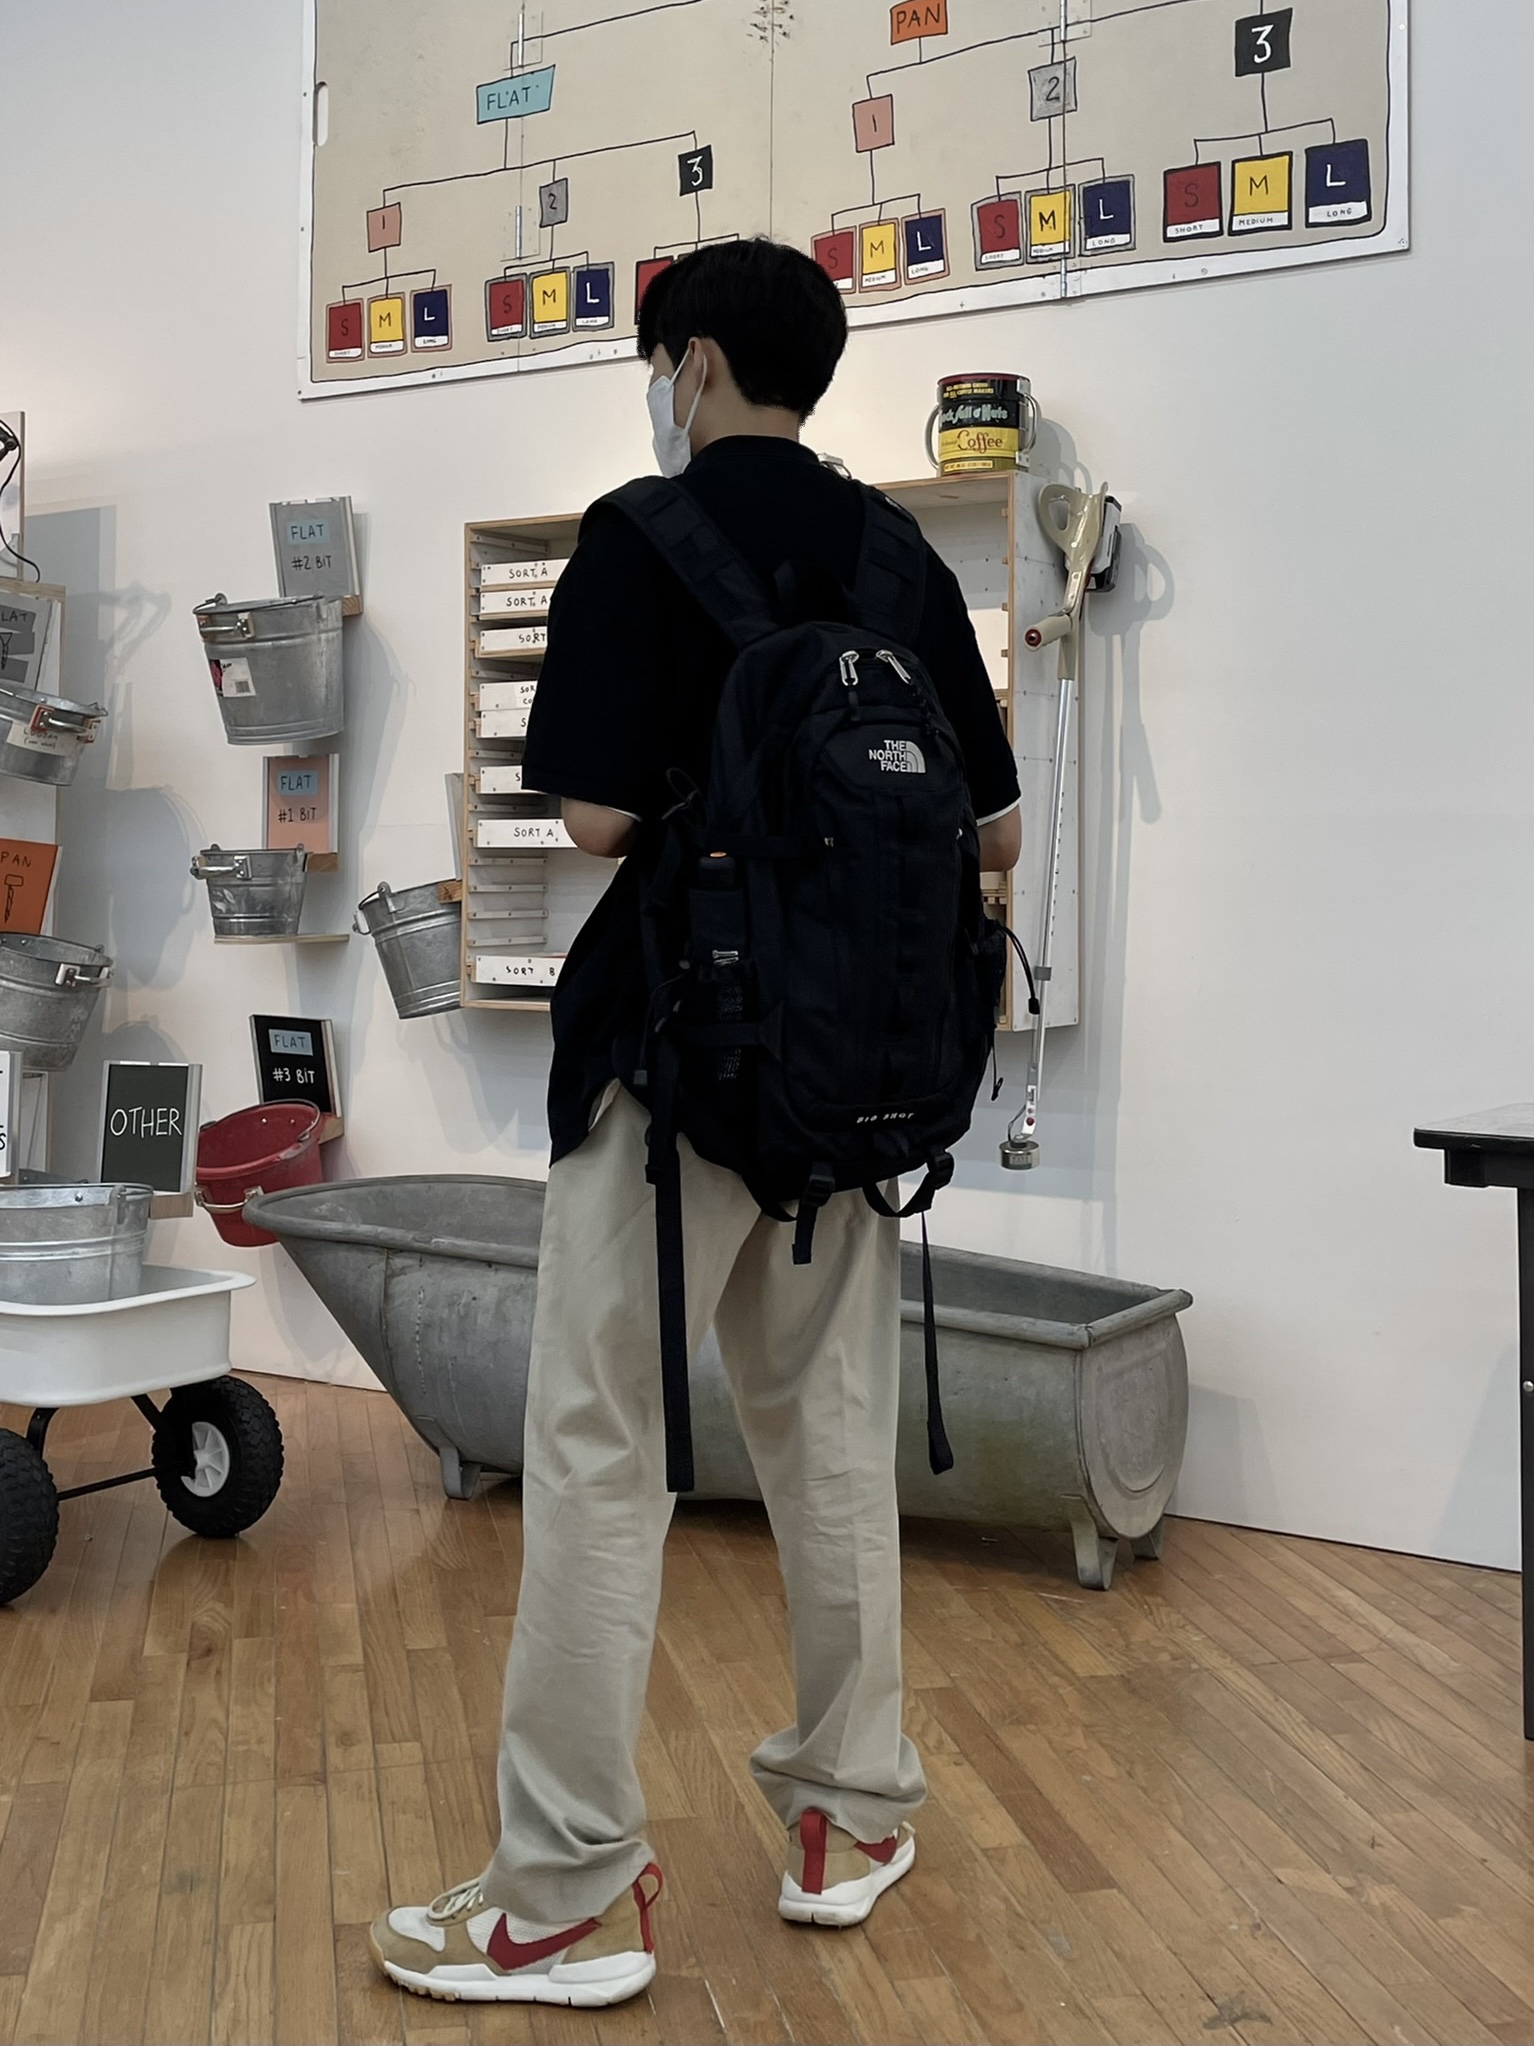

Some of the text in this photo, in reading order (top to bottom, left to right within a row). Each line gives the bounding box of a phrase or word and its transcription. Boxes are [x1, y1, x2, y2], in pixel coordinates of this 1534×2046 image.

[896, 3, 940, 34] PAN
[1251, 24, 1274, 63] 3
[1045, 76, 1061, 101] 2
[487, 86, 531, 111] FLAT
[687, 155, 703, 186] 3
[1326, 163, 1346, 187] L
[1249, 174, 1269, 196] M
[548, 193, 558, 210] 2
[1184, 182, 1199, 208] S
[1099, 199, 1114, 220] L
[1327, 208, 1352, 217] LONG
[993, 214, 1005, 239] S
[1038, 209, 1056, 232] M
[1238, 217, 1274, 226] MEDIUM
[1174, 224, 1204, 234] SHORT
[870, 240, 884, 258] M
[917, 231, 932, 251] L
[1092, 237, 1116, 246] LONG
[827, 247, 838, 269] S
[542, 288, 556, 306] M
[586, 282, 600, 303] L
[502, 295, 512, 314] S
[379, 312, 391, 328] M
[424, 307, 436, 321] L
[341, 318, 349, 336] S
[957, 429, 1003, 454] Coffee
[290, 524, 324, 540] FLAT
[291, 556, 311, 571] #2
[541, 567, 548, 576] A
[540, 595, 548, 605] A
[0, 611, 28, 622] LAT
[519, 632, 546, 643] SORT
[520, 685, 536, 694] SOR
[883, 739, 906, 751] THE
[868, 749, 906, 761] NORTH
[880, 760, 907, 772] FACE
[280, 775, 311, 791] FLAT
[278, 808, 294, 823] #1
[513, 827, 554, 837] SORT A
[1, 851, 31, 867] PAN
[506, 965, 556, 976] SORT B
[274, 1034, 306, 1048] FLAT
[272, 1067, 291, 1082] #3
[110, 1106, 182, 1139] OTHER
